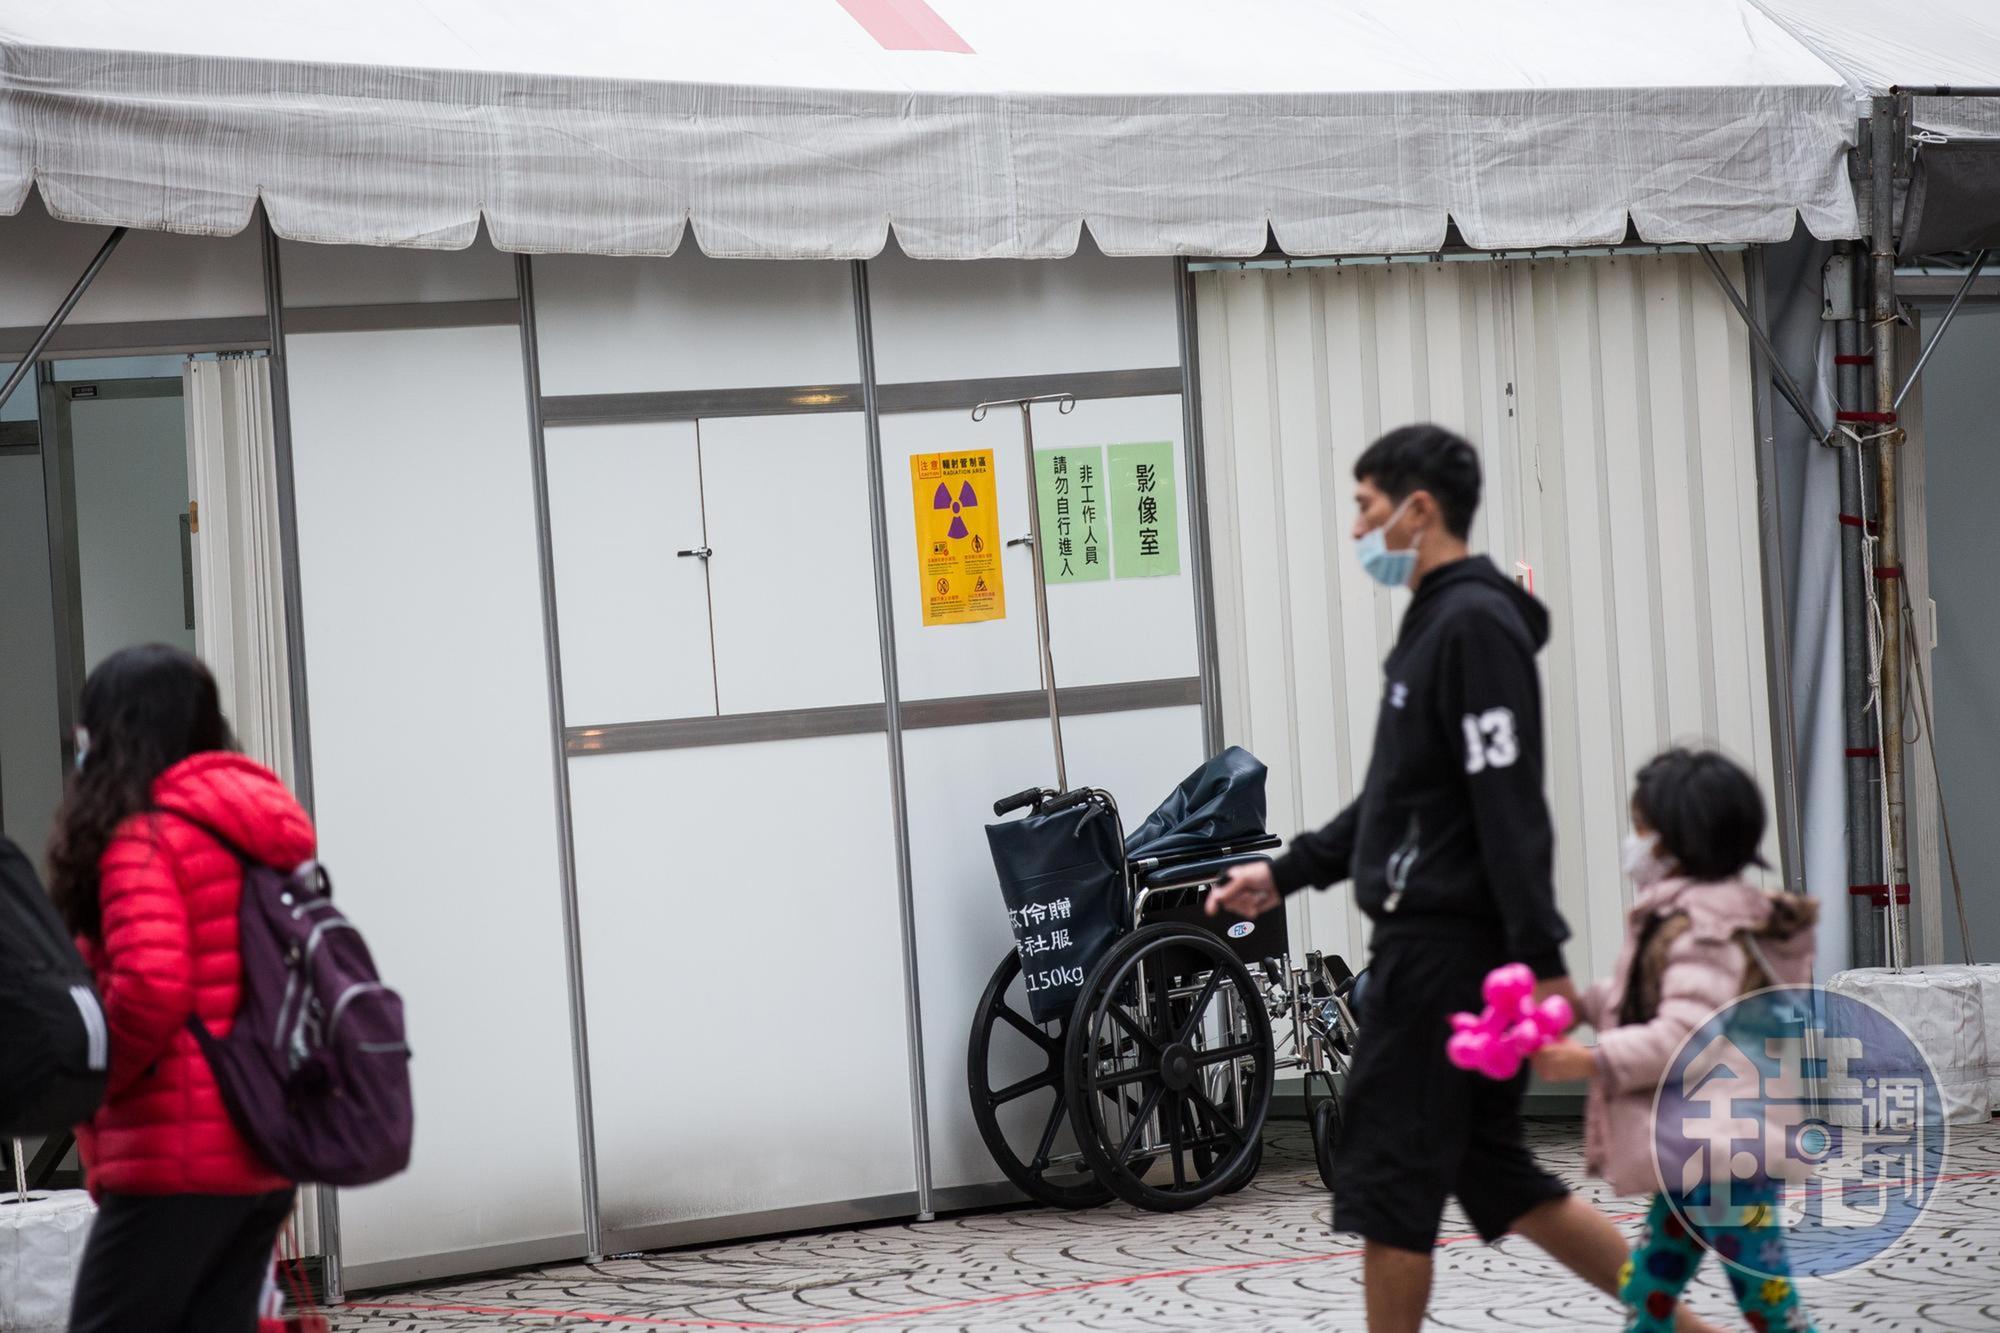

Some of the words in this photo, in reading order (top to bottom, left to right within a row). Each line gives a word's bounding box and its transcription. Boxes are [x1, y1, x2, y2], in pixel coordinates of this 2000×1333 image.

[1053, 456, 1074, 576] 請勿自行進入
[1080, 464, 1098, 565] 非工作人員
[1136, 464, 1159, 555] 影像室
[1462, 706, 1519, 775] 13
